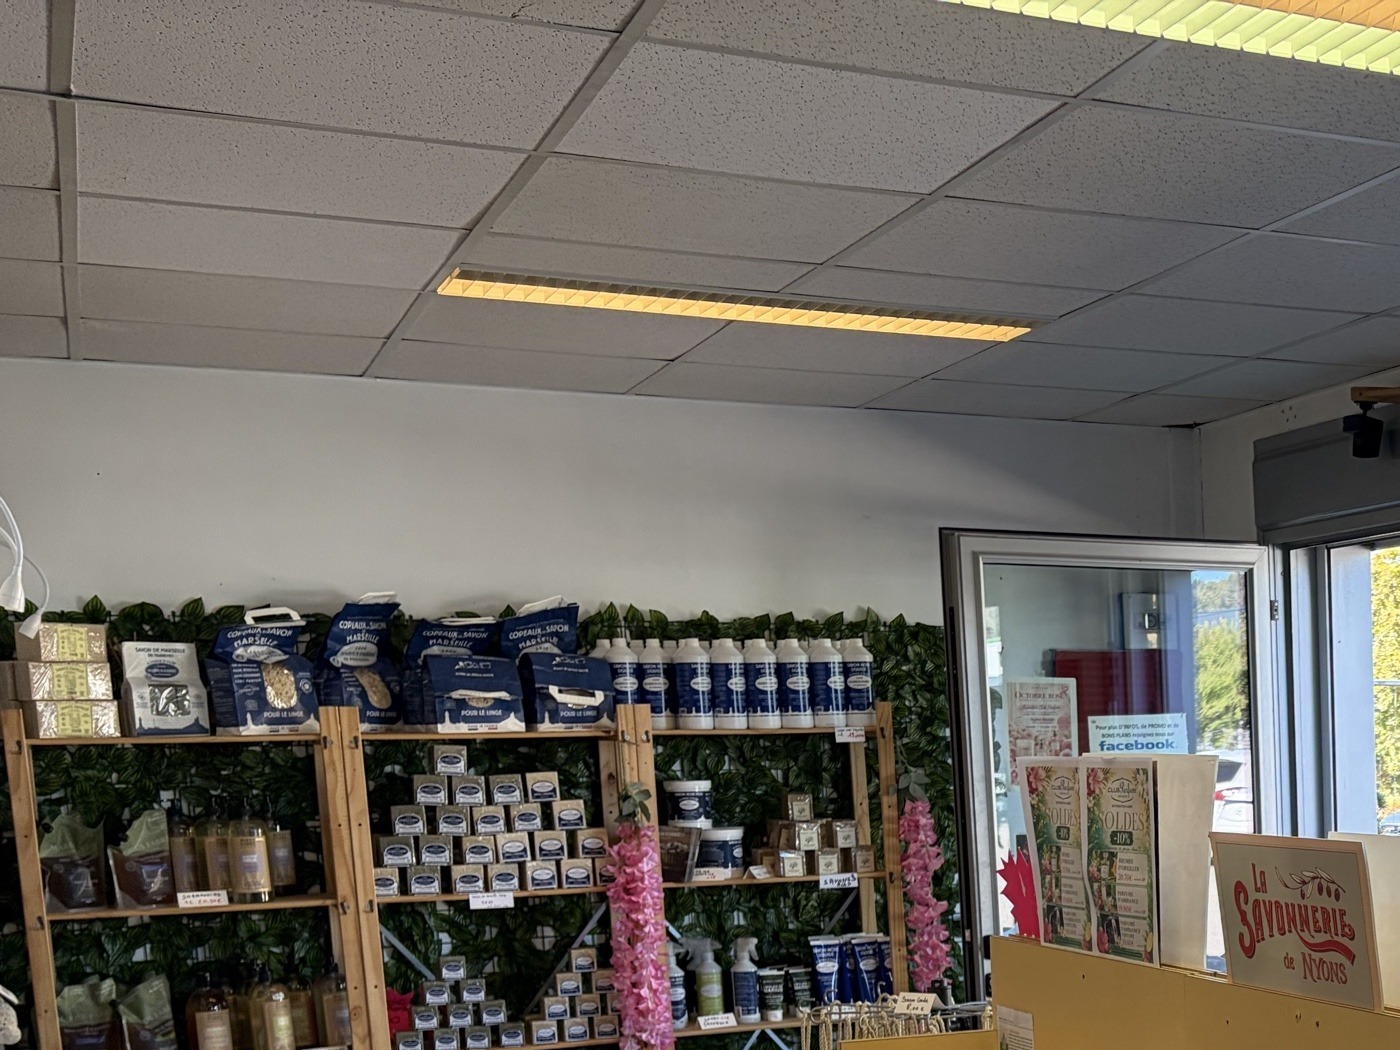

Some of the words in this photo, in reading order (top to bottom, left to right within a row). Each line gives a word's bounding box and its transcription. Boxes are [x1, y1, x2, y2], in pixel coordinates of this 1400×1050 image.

[423, 630, 457, 639] COPEAUX
[509, 628, 541, 640] COPEAUX
[546, 624, 569, 633] SAVON
[429, 638, 473, 648] MARSEILLE
[519, 636, 558, 649] MARSEILLE
[1099, 739, 1175, 751] facebook
[1045, 807, 1078, 827] SOLDES
[1101, 811, 1145, 831] SOLDES
[1113, 832, 1131, 844] -10%
[1252, 863, 1267, 893] LA
[1234, 880, 1355, 959] SAVONNERIE
[1284, 952, 1295, 970] de
[1301, 952, 1347, 985] NYONS
